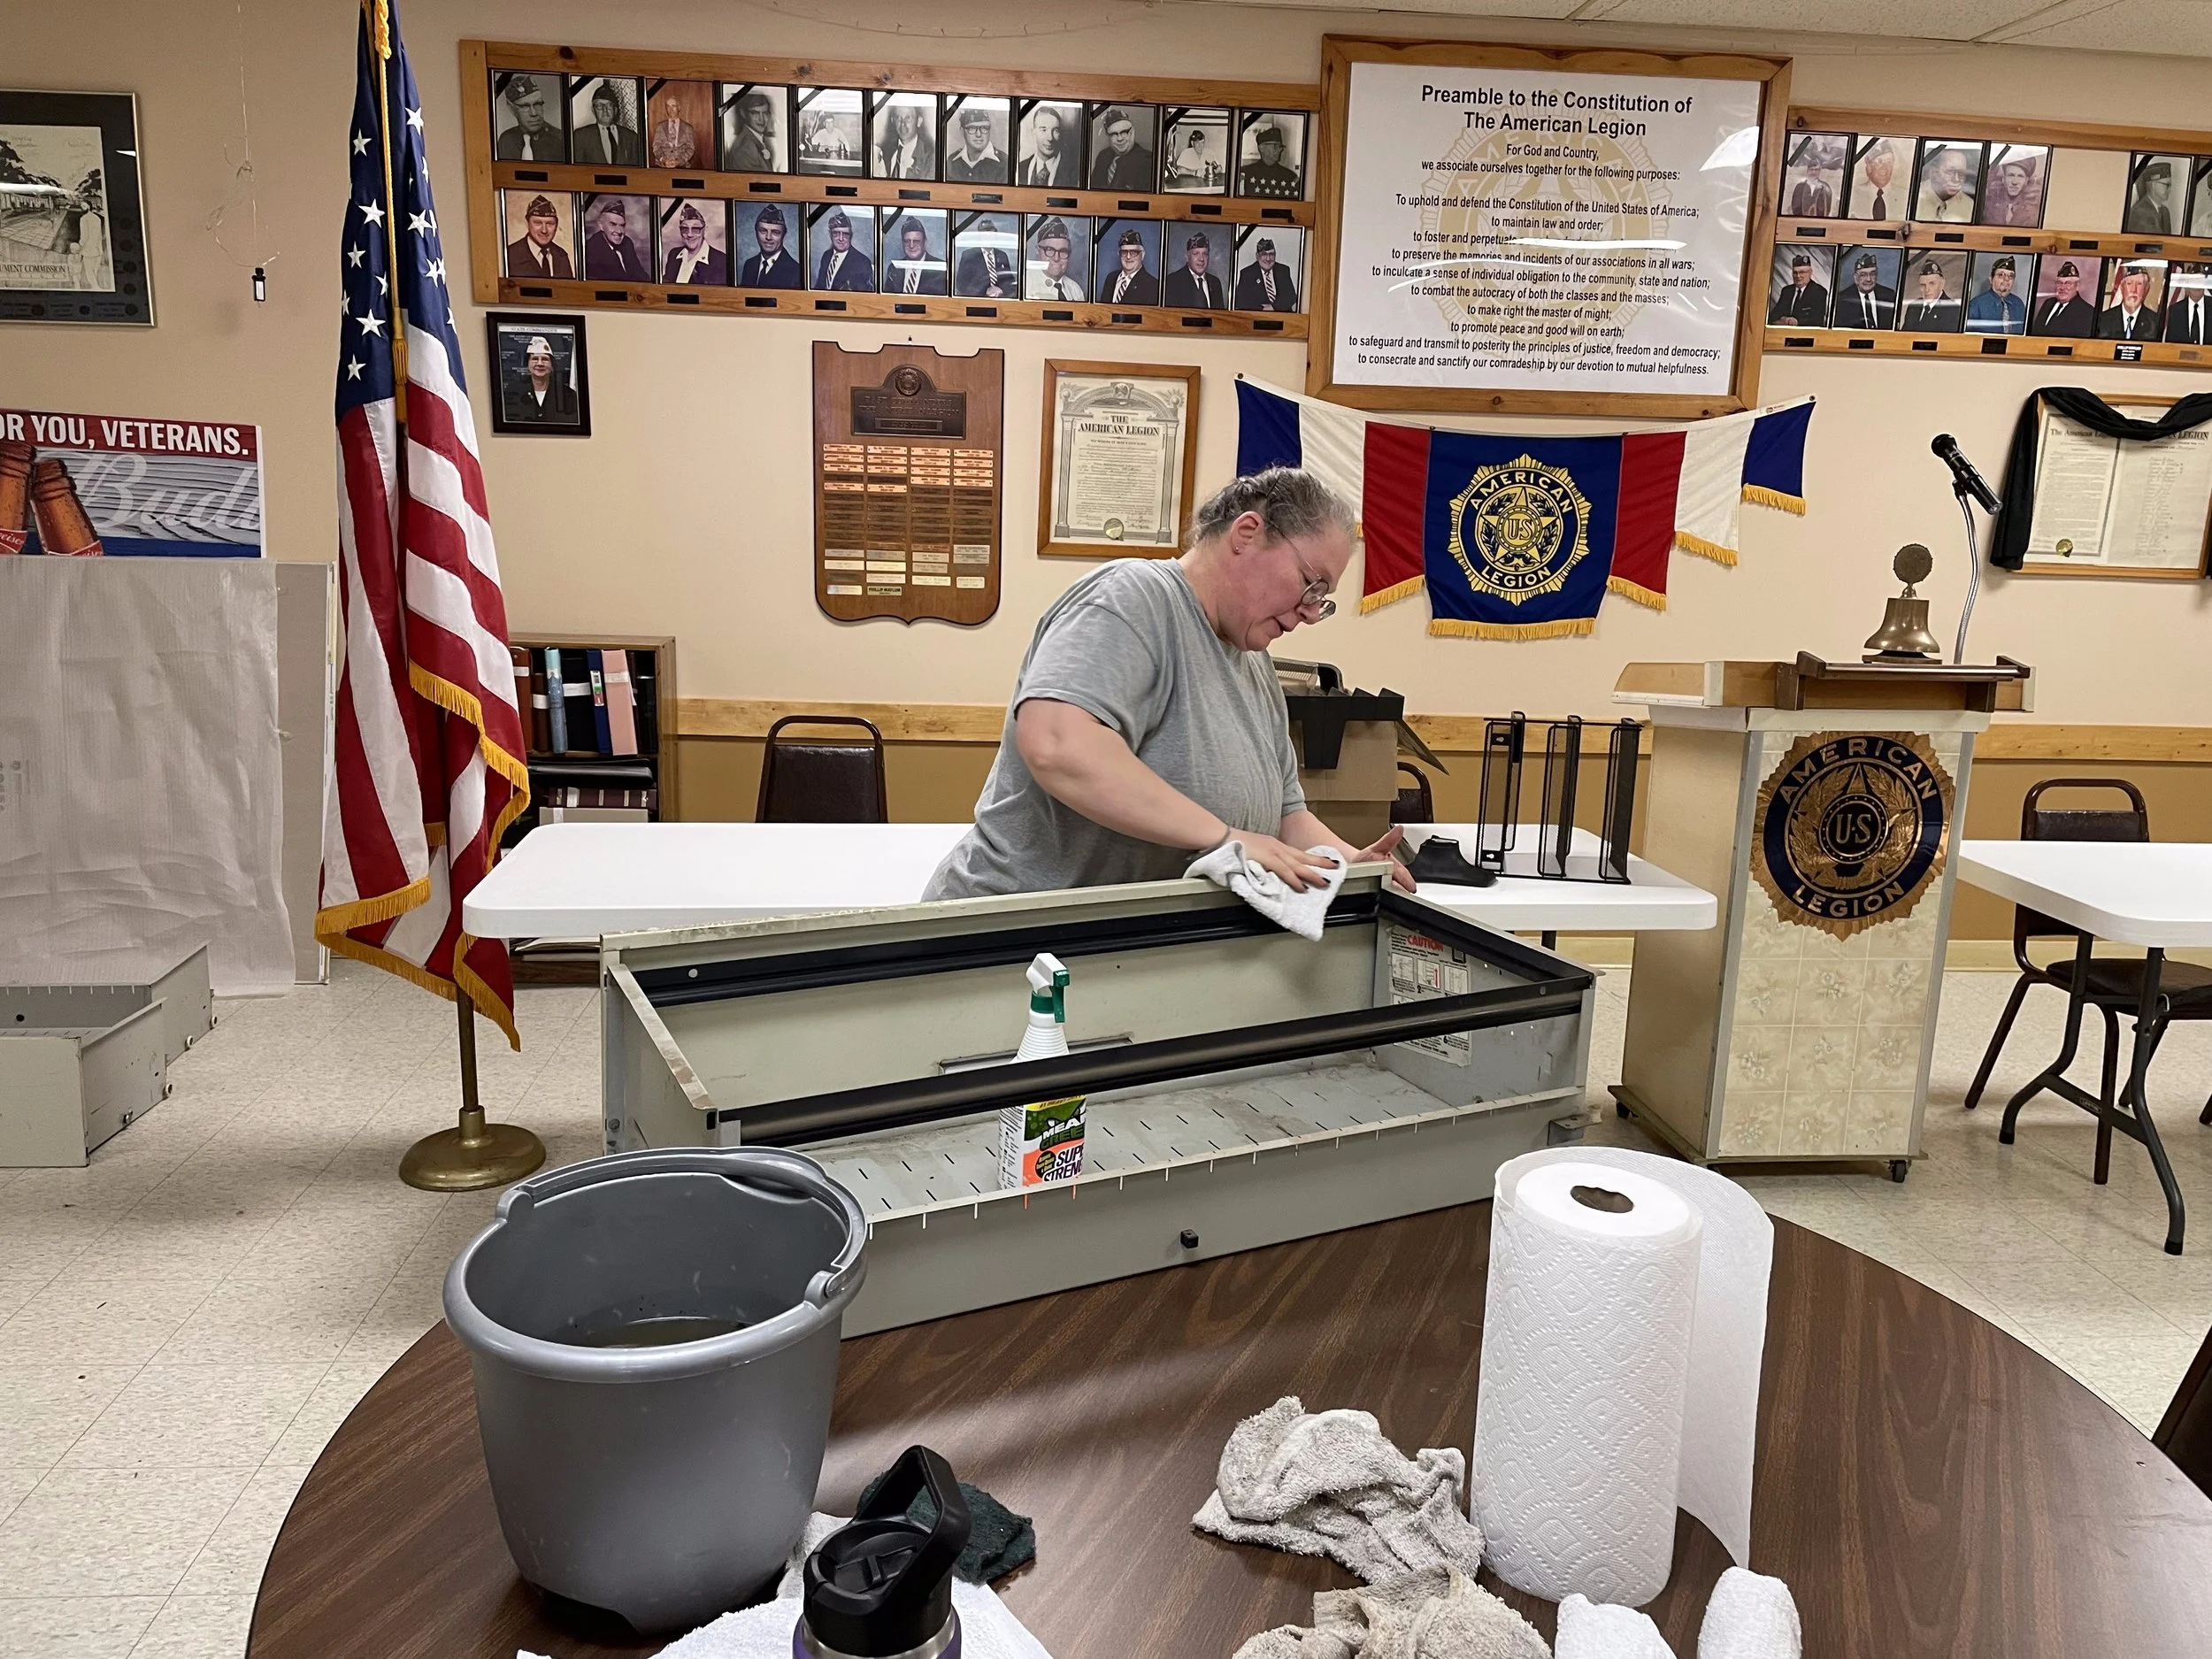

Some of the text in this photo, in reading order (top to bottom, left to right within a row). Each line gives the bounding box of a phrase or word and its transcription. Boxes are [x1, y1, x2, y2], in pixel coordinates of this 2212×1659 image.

[1421, 83, 1694, 114] Preamble to the Constitution of
[1463, 110, 1647, 140] The American Legion
[1505, 142, 1600, 163] For God and Country,
[1420, 159, 1681, 183] we associate ourselves together for the following purposes:
[1394, 192, 1700, 219] To uphold and defend the Constitution of the United States of America;
[1490, 215, 1605, 232] to maintain law and order;
[1413, 233, 1423, 242] to
[1424, 233, 1450, 244] foster
[1451, 233, 1470, 244] and
[1391, 247, 1402, 260] to
[1402, 250, 1442, 263] preserve
[1442, 248, 1458, 261] the
[1503, 251, 1522, 263] and
[1522, 251, 1563, 265] incidents
[1563, 253, 1575, 266] of
[1574, 256, 1592, 266] our
[1591, 255, 1647, 269] associations
[1647, 257, 1658, 270] in
[1657, 257, 1671, 270] all
[1671, 259, 1696, 272] wars;
[1371, 264, 1711, 290] to inculcate a sense of individual obligation to the community, state and nation;
[1409, 284, 1671, 306] to combat the autocracy of both the classes and the masses;
[1466, 303, 1613, 323] to make right the master of might;
[1449, 320, 1625, 339] to promote peace and good will on earth;
[1348, 334, 1721, 360] to safeguard and transmit to posterity the principles of justice, freedom and democracy;
[1357, 352, 1709, 377] to consecrate and sanctify our comradeship by our devotion to mutual helpfulness.
[30, 414, 96, 449] YOU,
[100, 419, 250, 456] VETERANS.
[1079, 423, 1160, 436] AMERICAN LEGION
[2177, 430, 2209, 441] LEGION
[1470, 472, 1573, 514] AMERICAN
[1481, 565, 1551, 588] LEGION
[1779, 738, 1938, 805] AMERICAN
[1792, 881, 1906, 918] LEGION
